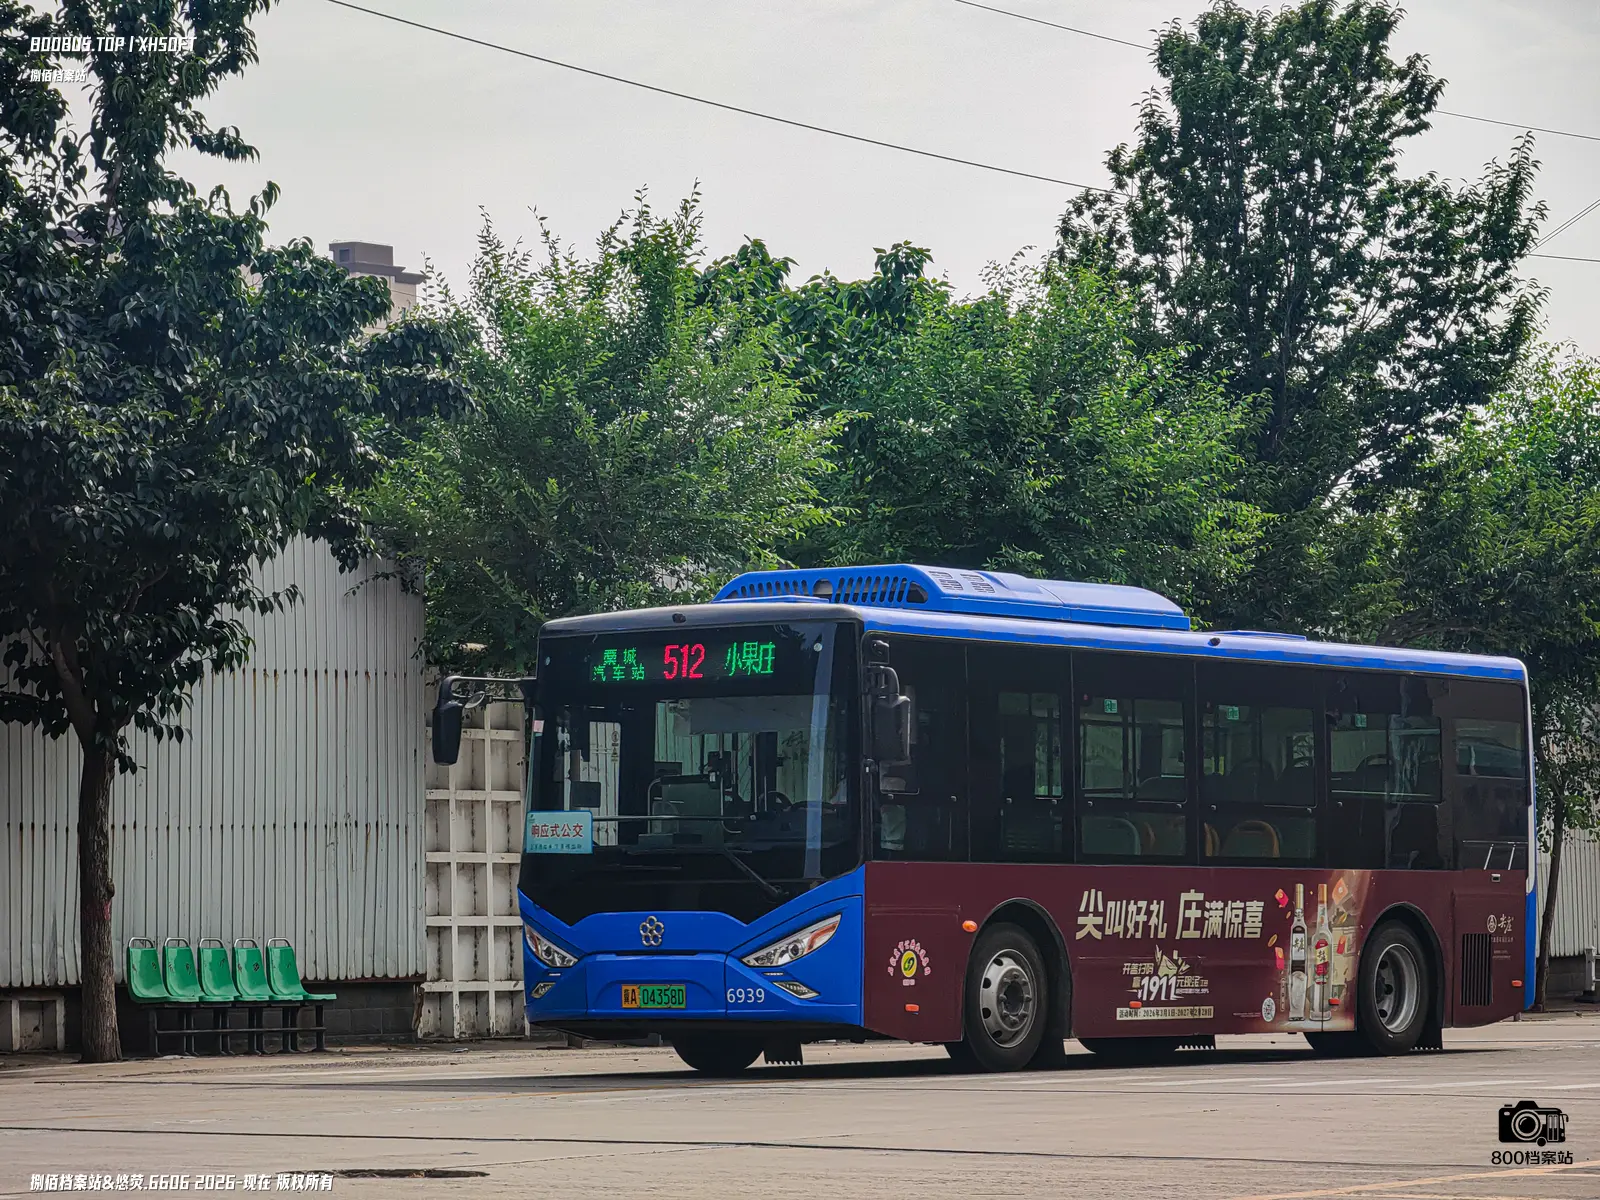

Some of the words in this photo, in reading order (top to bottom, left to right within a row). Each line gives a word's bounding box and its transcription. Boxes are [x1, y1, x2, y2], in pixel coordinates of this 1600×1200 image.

[664, 643, 706, 679] 512
[724, 641, 776, 676] 小果庄
[592, 663, 645, 682] 汽车站
[531, 823, 584, 838] 响应式公交
[1075, 888, 1168, 940] 尖叫好礼
[1175, 888, 1265, 940] 庄满惊喜
[727, 988, 765, 1003] 6939
